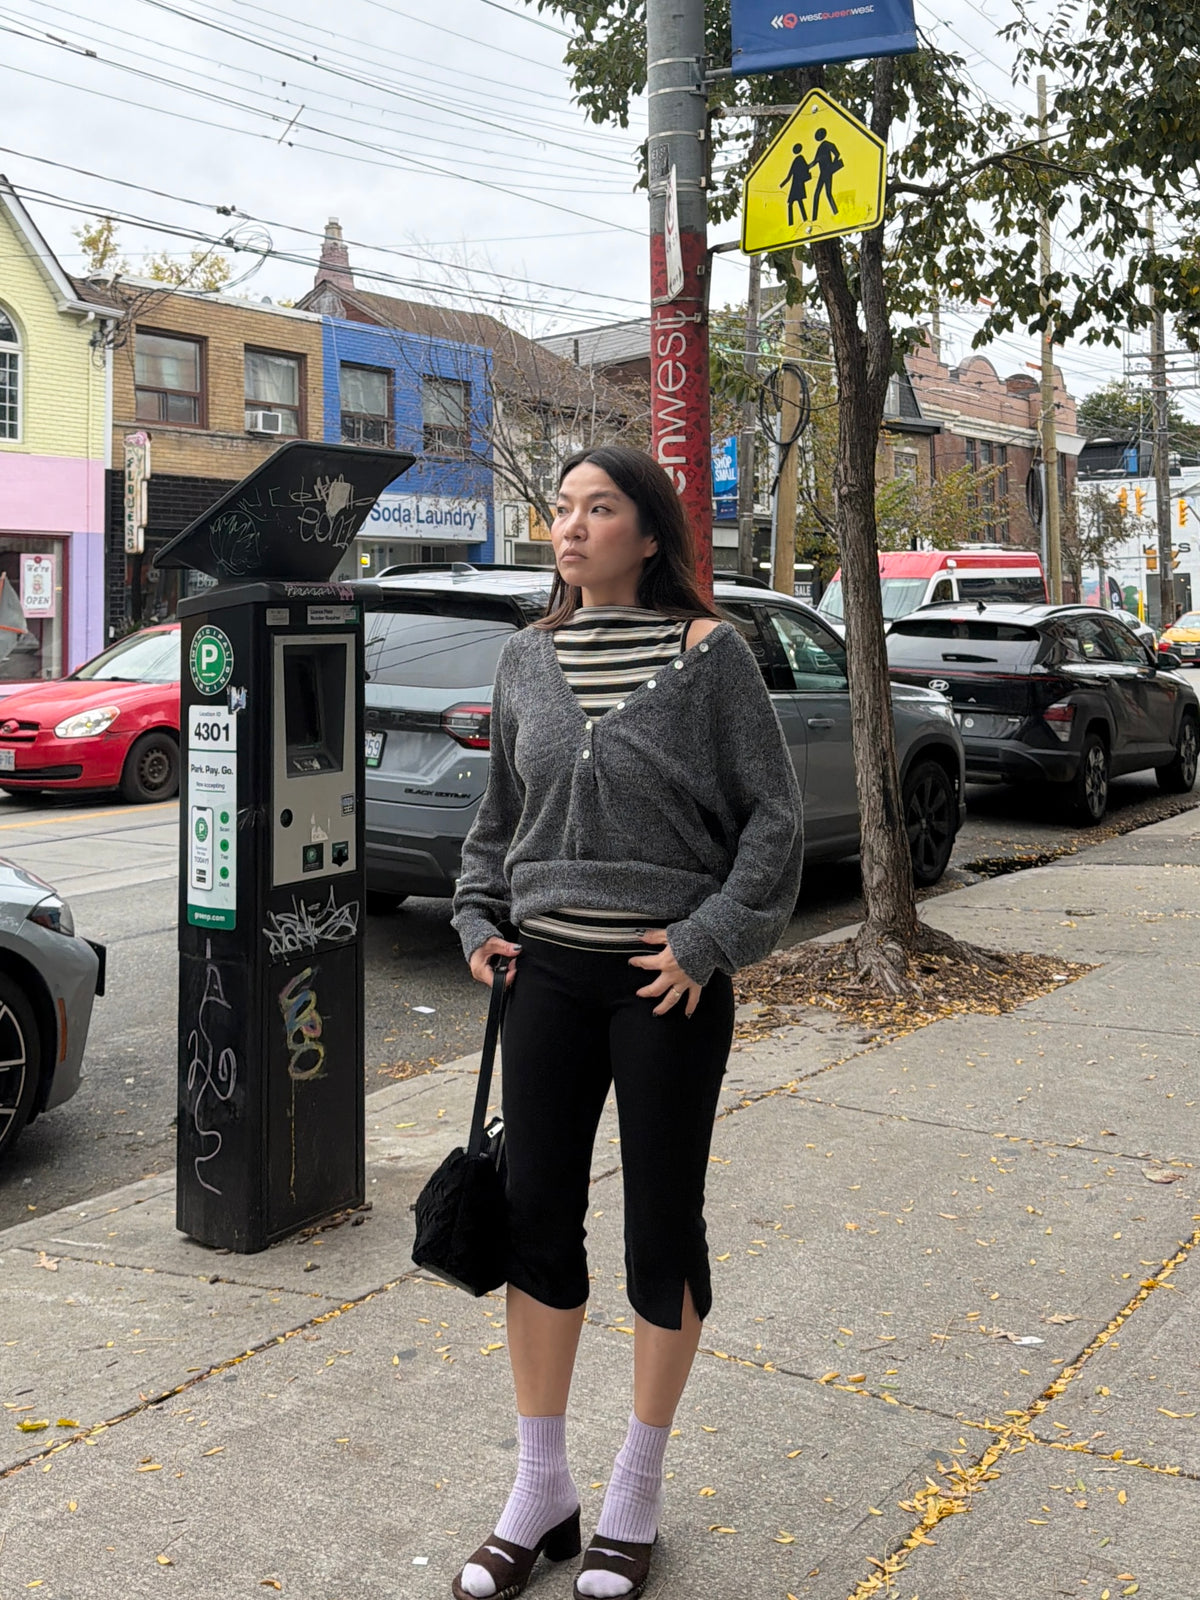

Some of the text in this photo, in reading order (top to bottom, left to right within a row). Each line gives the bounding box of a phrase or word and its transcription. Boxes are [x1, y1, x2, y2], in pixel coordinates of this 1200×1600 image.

[713, 456, 732, 470] SHOP
[715, 468, 737, 482] SMALL
[371, 502, 477, 530] Soda Laundry
[794, 585, 811, 597] SALE
[26, 595, 50, 605] OPEN
[191, 628, 232, 659] MUNICIPAL
[201, 644, 219, 671] P
[191, 665, 231, 693] PARKING
[194, 722, 230, 742] 4301
[190, 764, 234, 777] Park. Pay. Go.
[404, 788, 472, 799] BLACK EDITION
